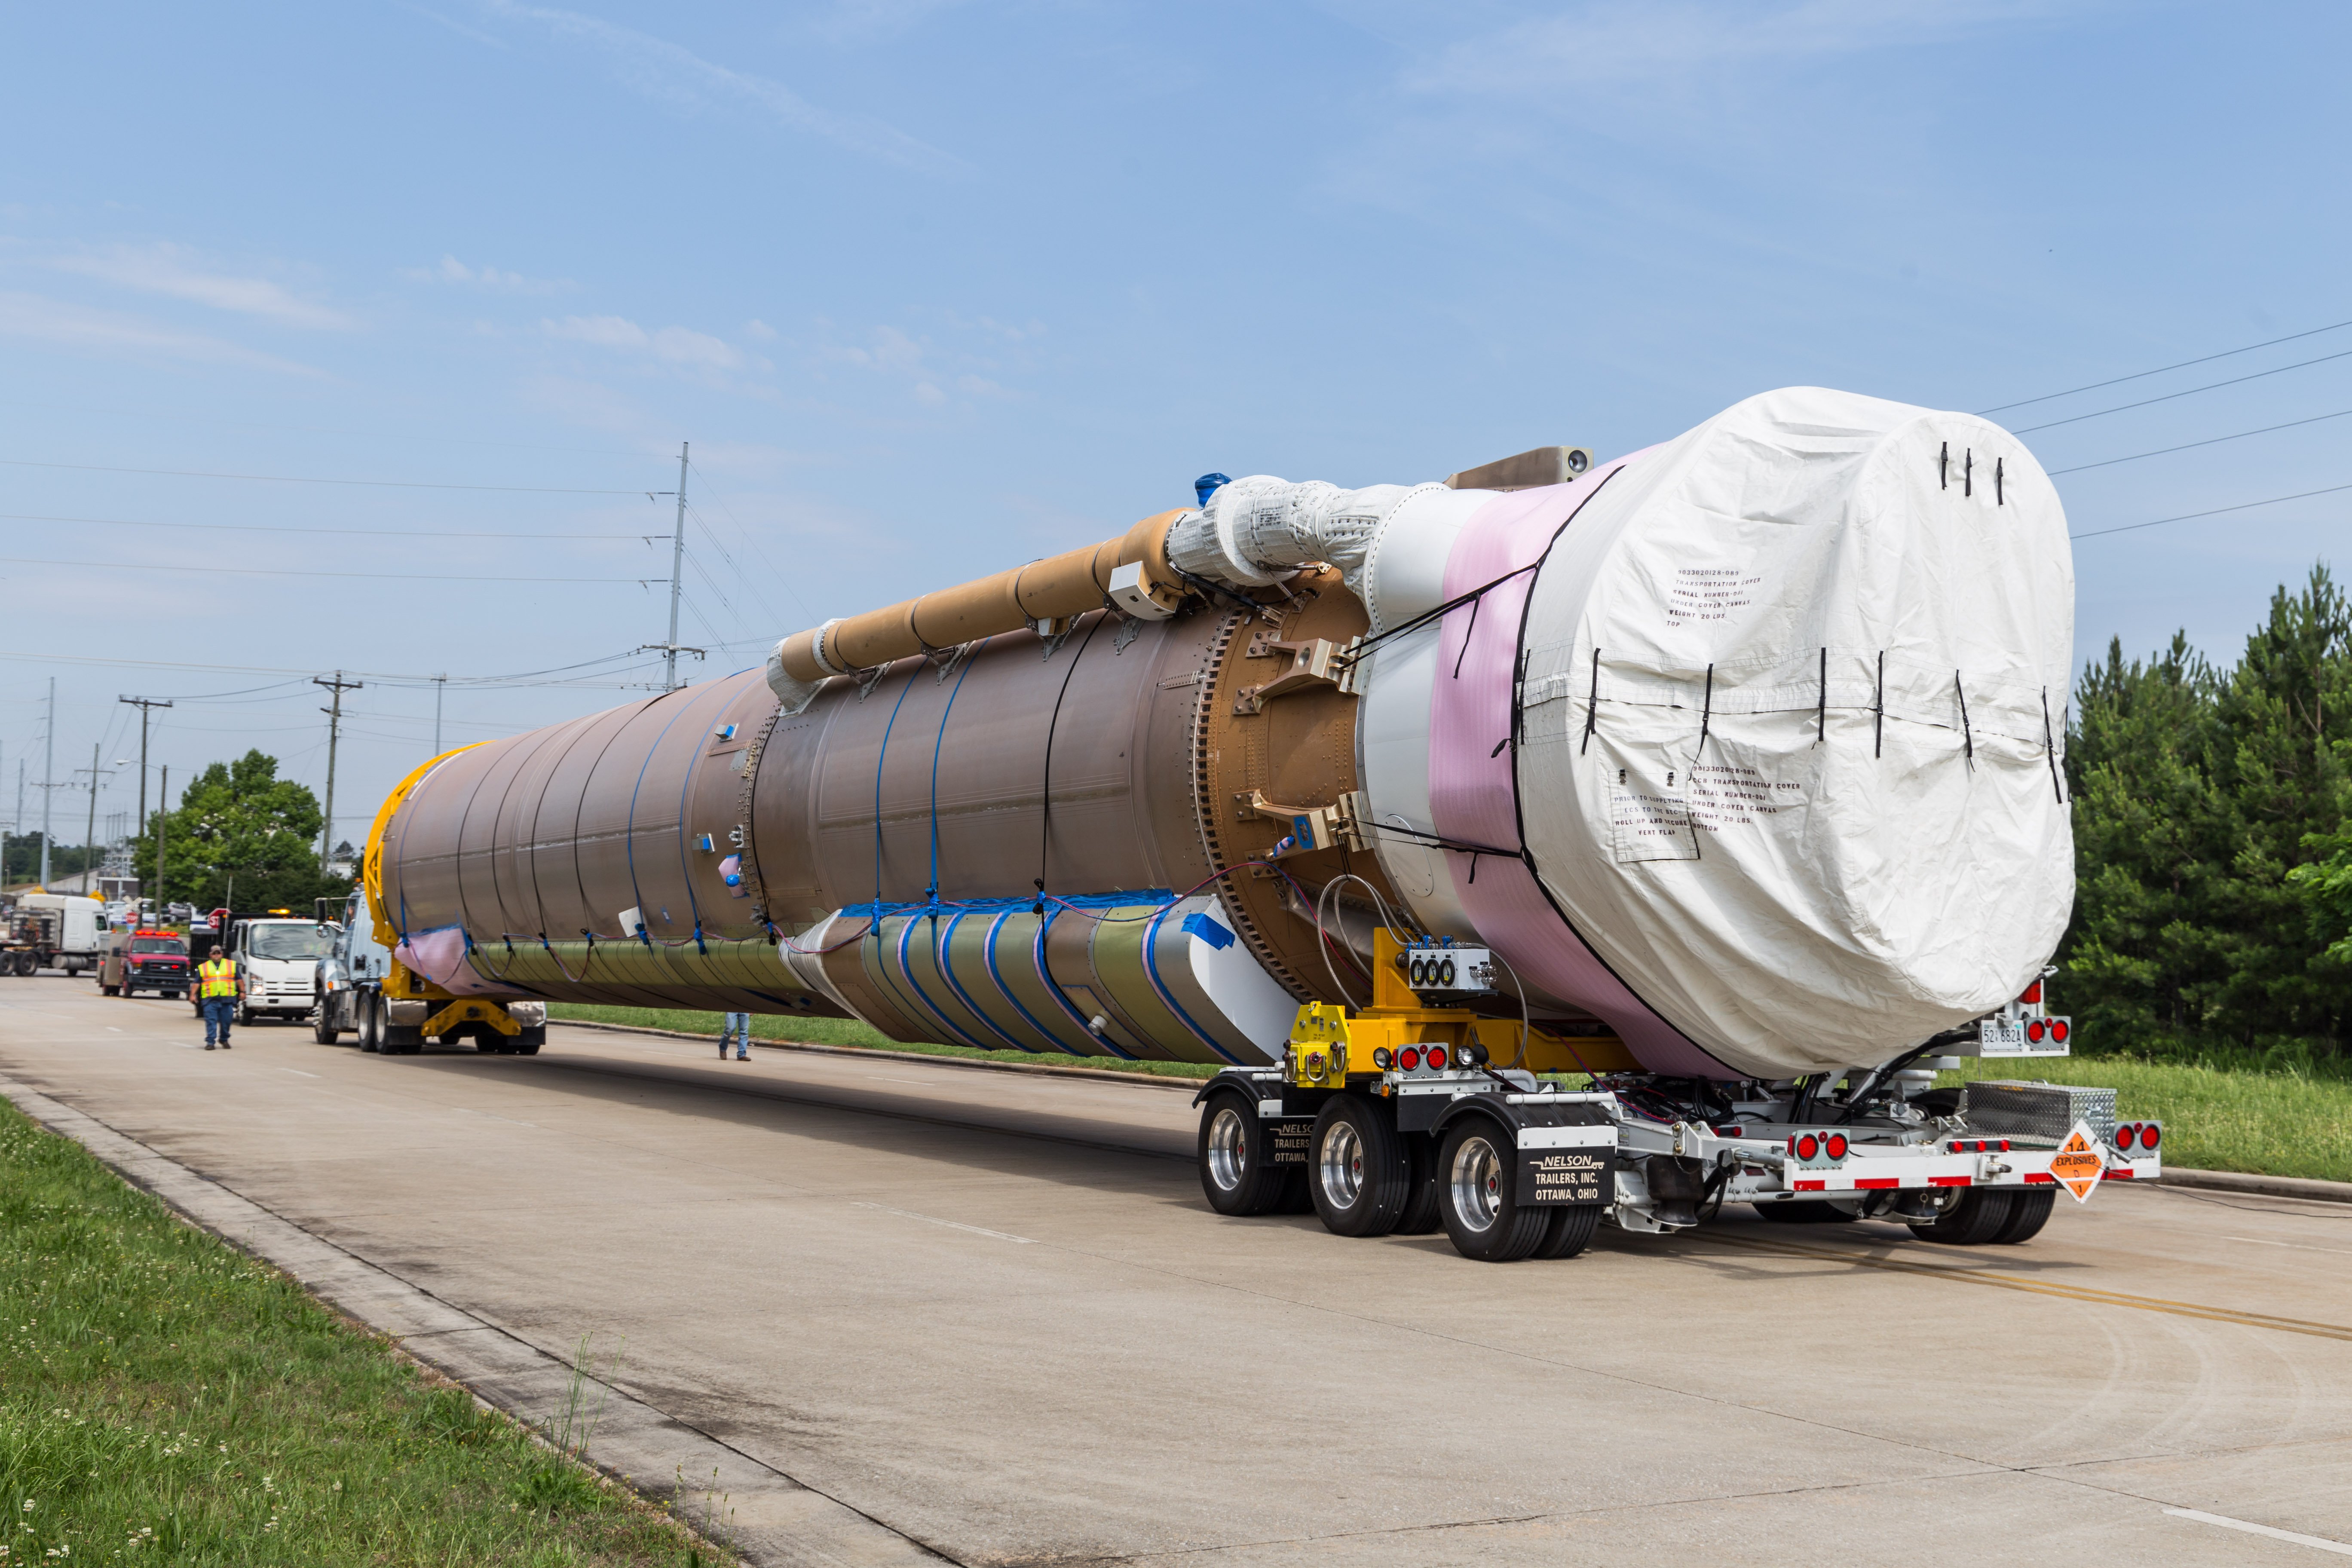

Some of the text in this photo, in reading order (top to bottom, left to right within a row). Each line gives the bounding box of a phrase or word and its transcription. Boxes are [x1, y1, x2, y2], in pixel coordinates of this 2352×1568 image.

[1671, 599, 1693, 607] UNDER
[1669, 609, 1695, 618] WEIGHT
[1714, 779, 1771, 789] TRANSPORTATION
[1725, 791, 1765, 801] NUMBER-001
[1693, 823, 1718, 831] BOTTOM
[209, 916, 220, 926] ST
[1984, 1030, 1994, 1042] 52
[2001, 1029, 2021, 1042] 682A
[1282, 1124, 1314, 1133] NELSO
[1275, 1153, 1308, 1163] OTTAWA,
[1544, 1155, 1592, 1167] NELSON
[2056, 1155, 2096, 1166] EXPLOSIVES
[1535, 1172, 1598, 1185] TRAILERS, INC.
[2078, 1184, 2082, 1193] 1
[1536, 1188, 1598, 1201] OTTAWA, OHIO
